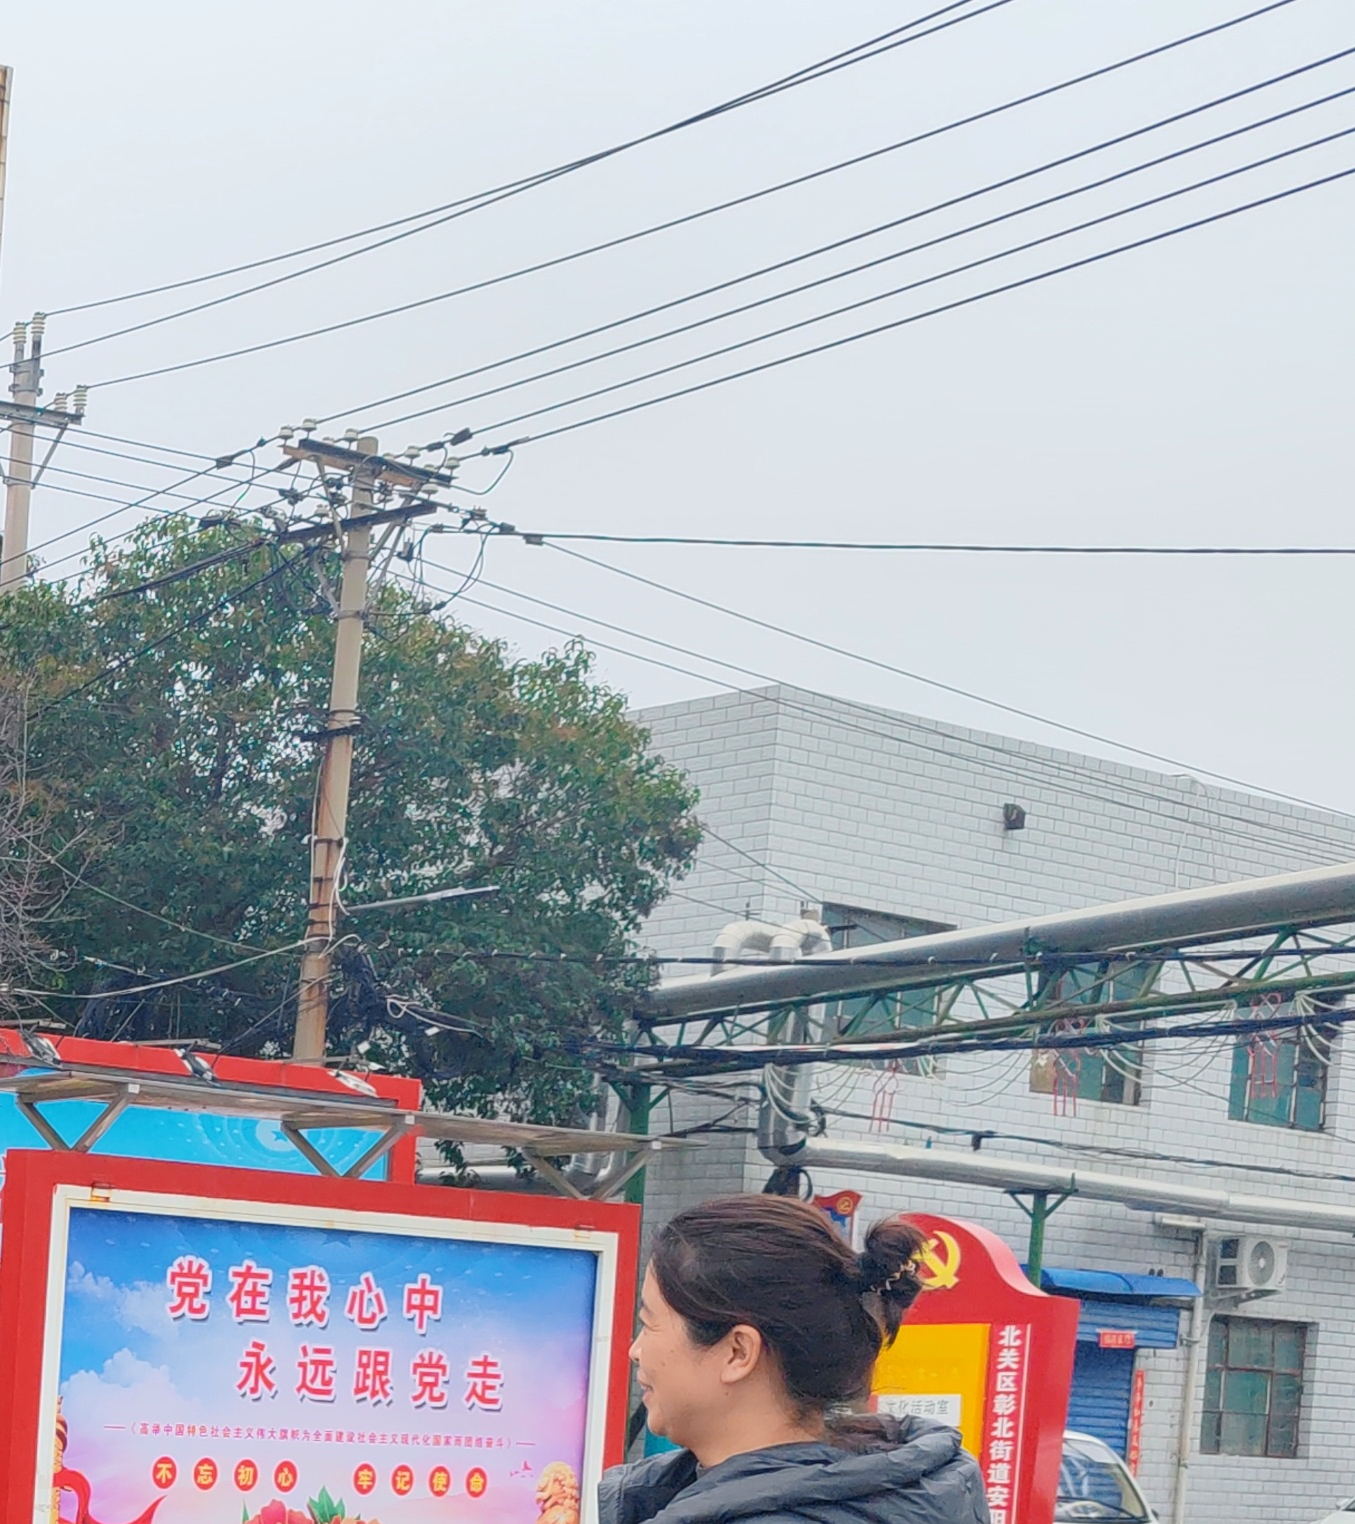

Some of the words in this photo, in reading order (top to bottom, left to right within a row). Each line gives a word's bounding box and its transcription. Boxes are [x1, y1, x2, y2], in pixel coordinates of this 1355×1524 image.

[166, 1255, 446, 1333] 党在我心中
[237, 1339, 507, 1409] 永远跟党走
[156, 1462, 294, 1486] 不忘初心
[357, 1468, 484, 1492] 牢记使命
